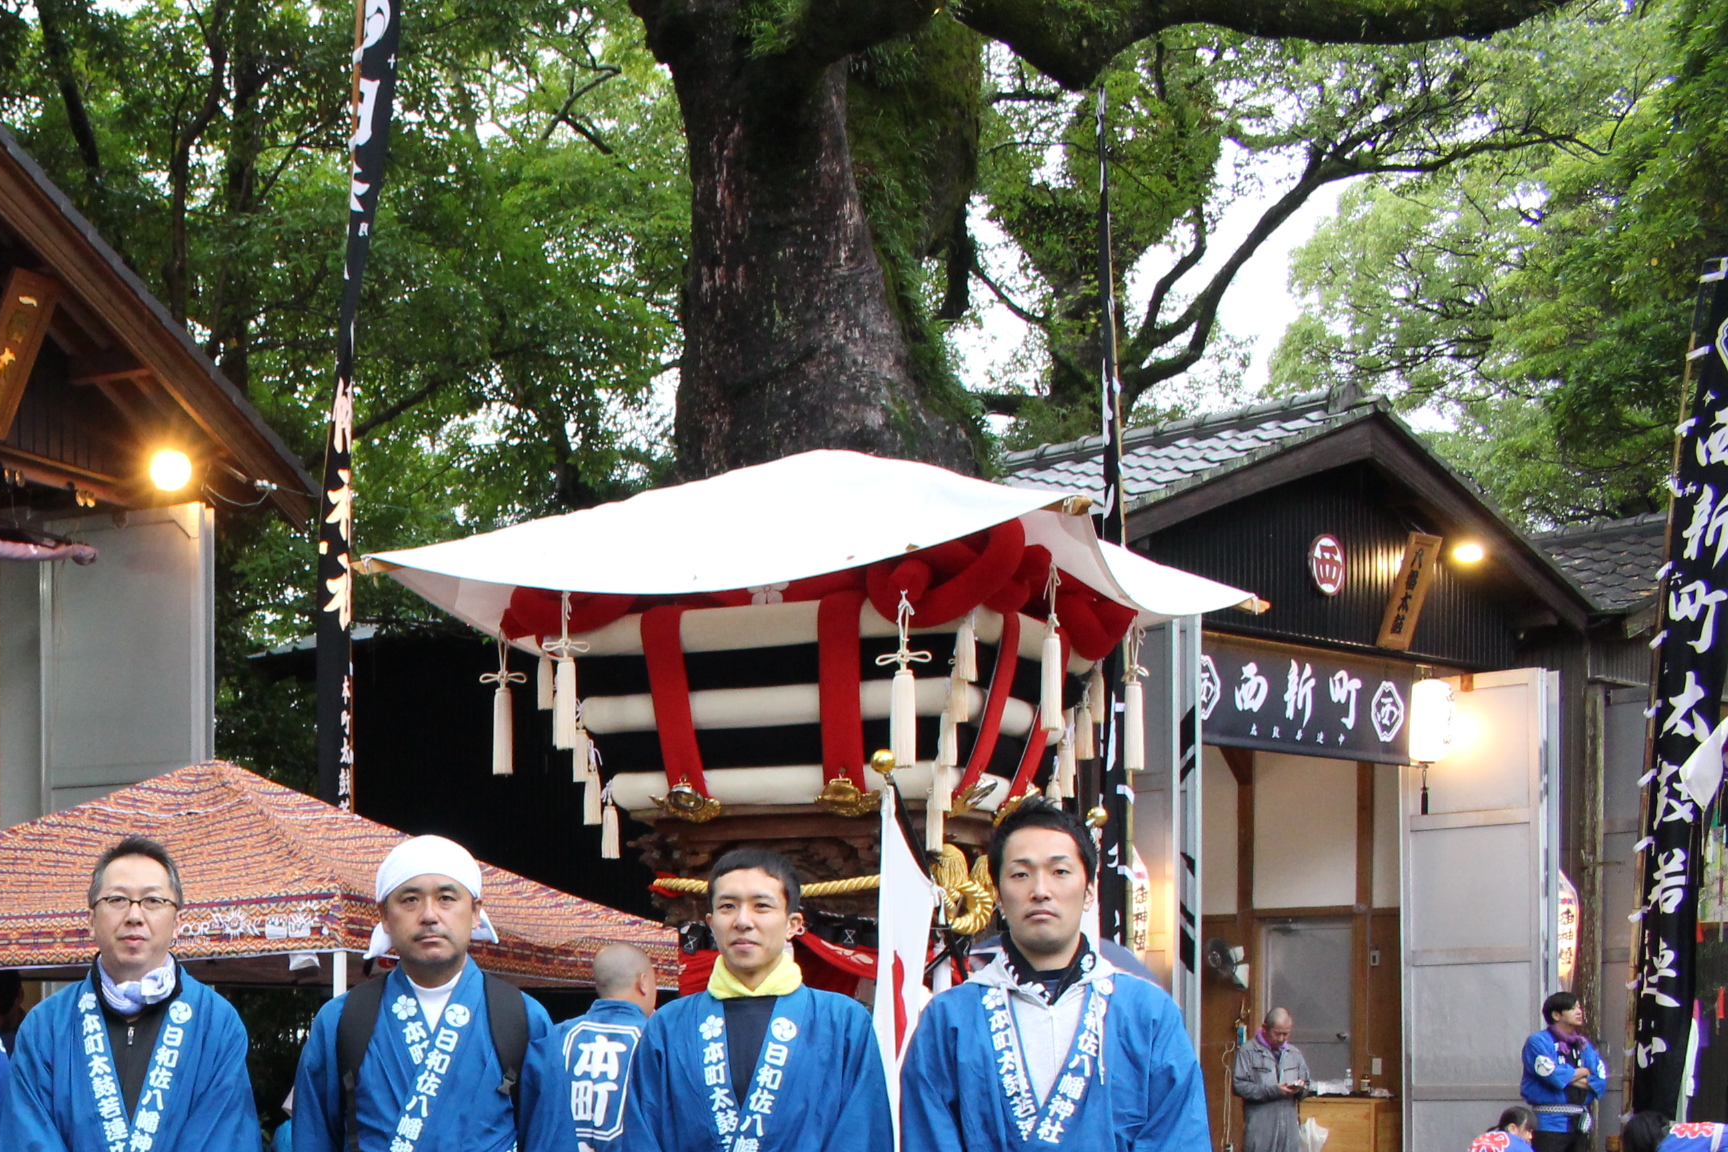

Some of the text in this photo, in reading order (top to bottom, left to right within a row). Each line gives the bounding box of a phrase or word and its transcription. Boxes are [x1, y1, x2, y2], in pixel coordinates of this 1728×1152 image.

[1234, 658, 1362, 730] 西新町
[571, 1034, 628, 1127] 本町
